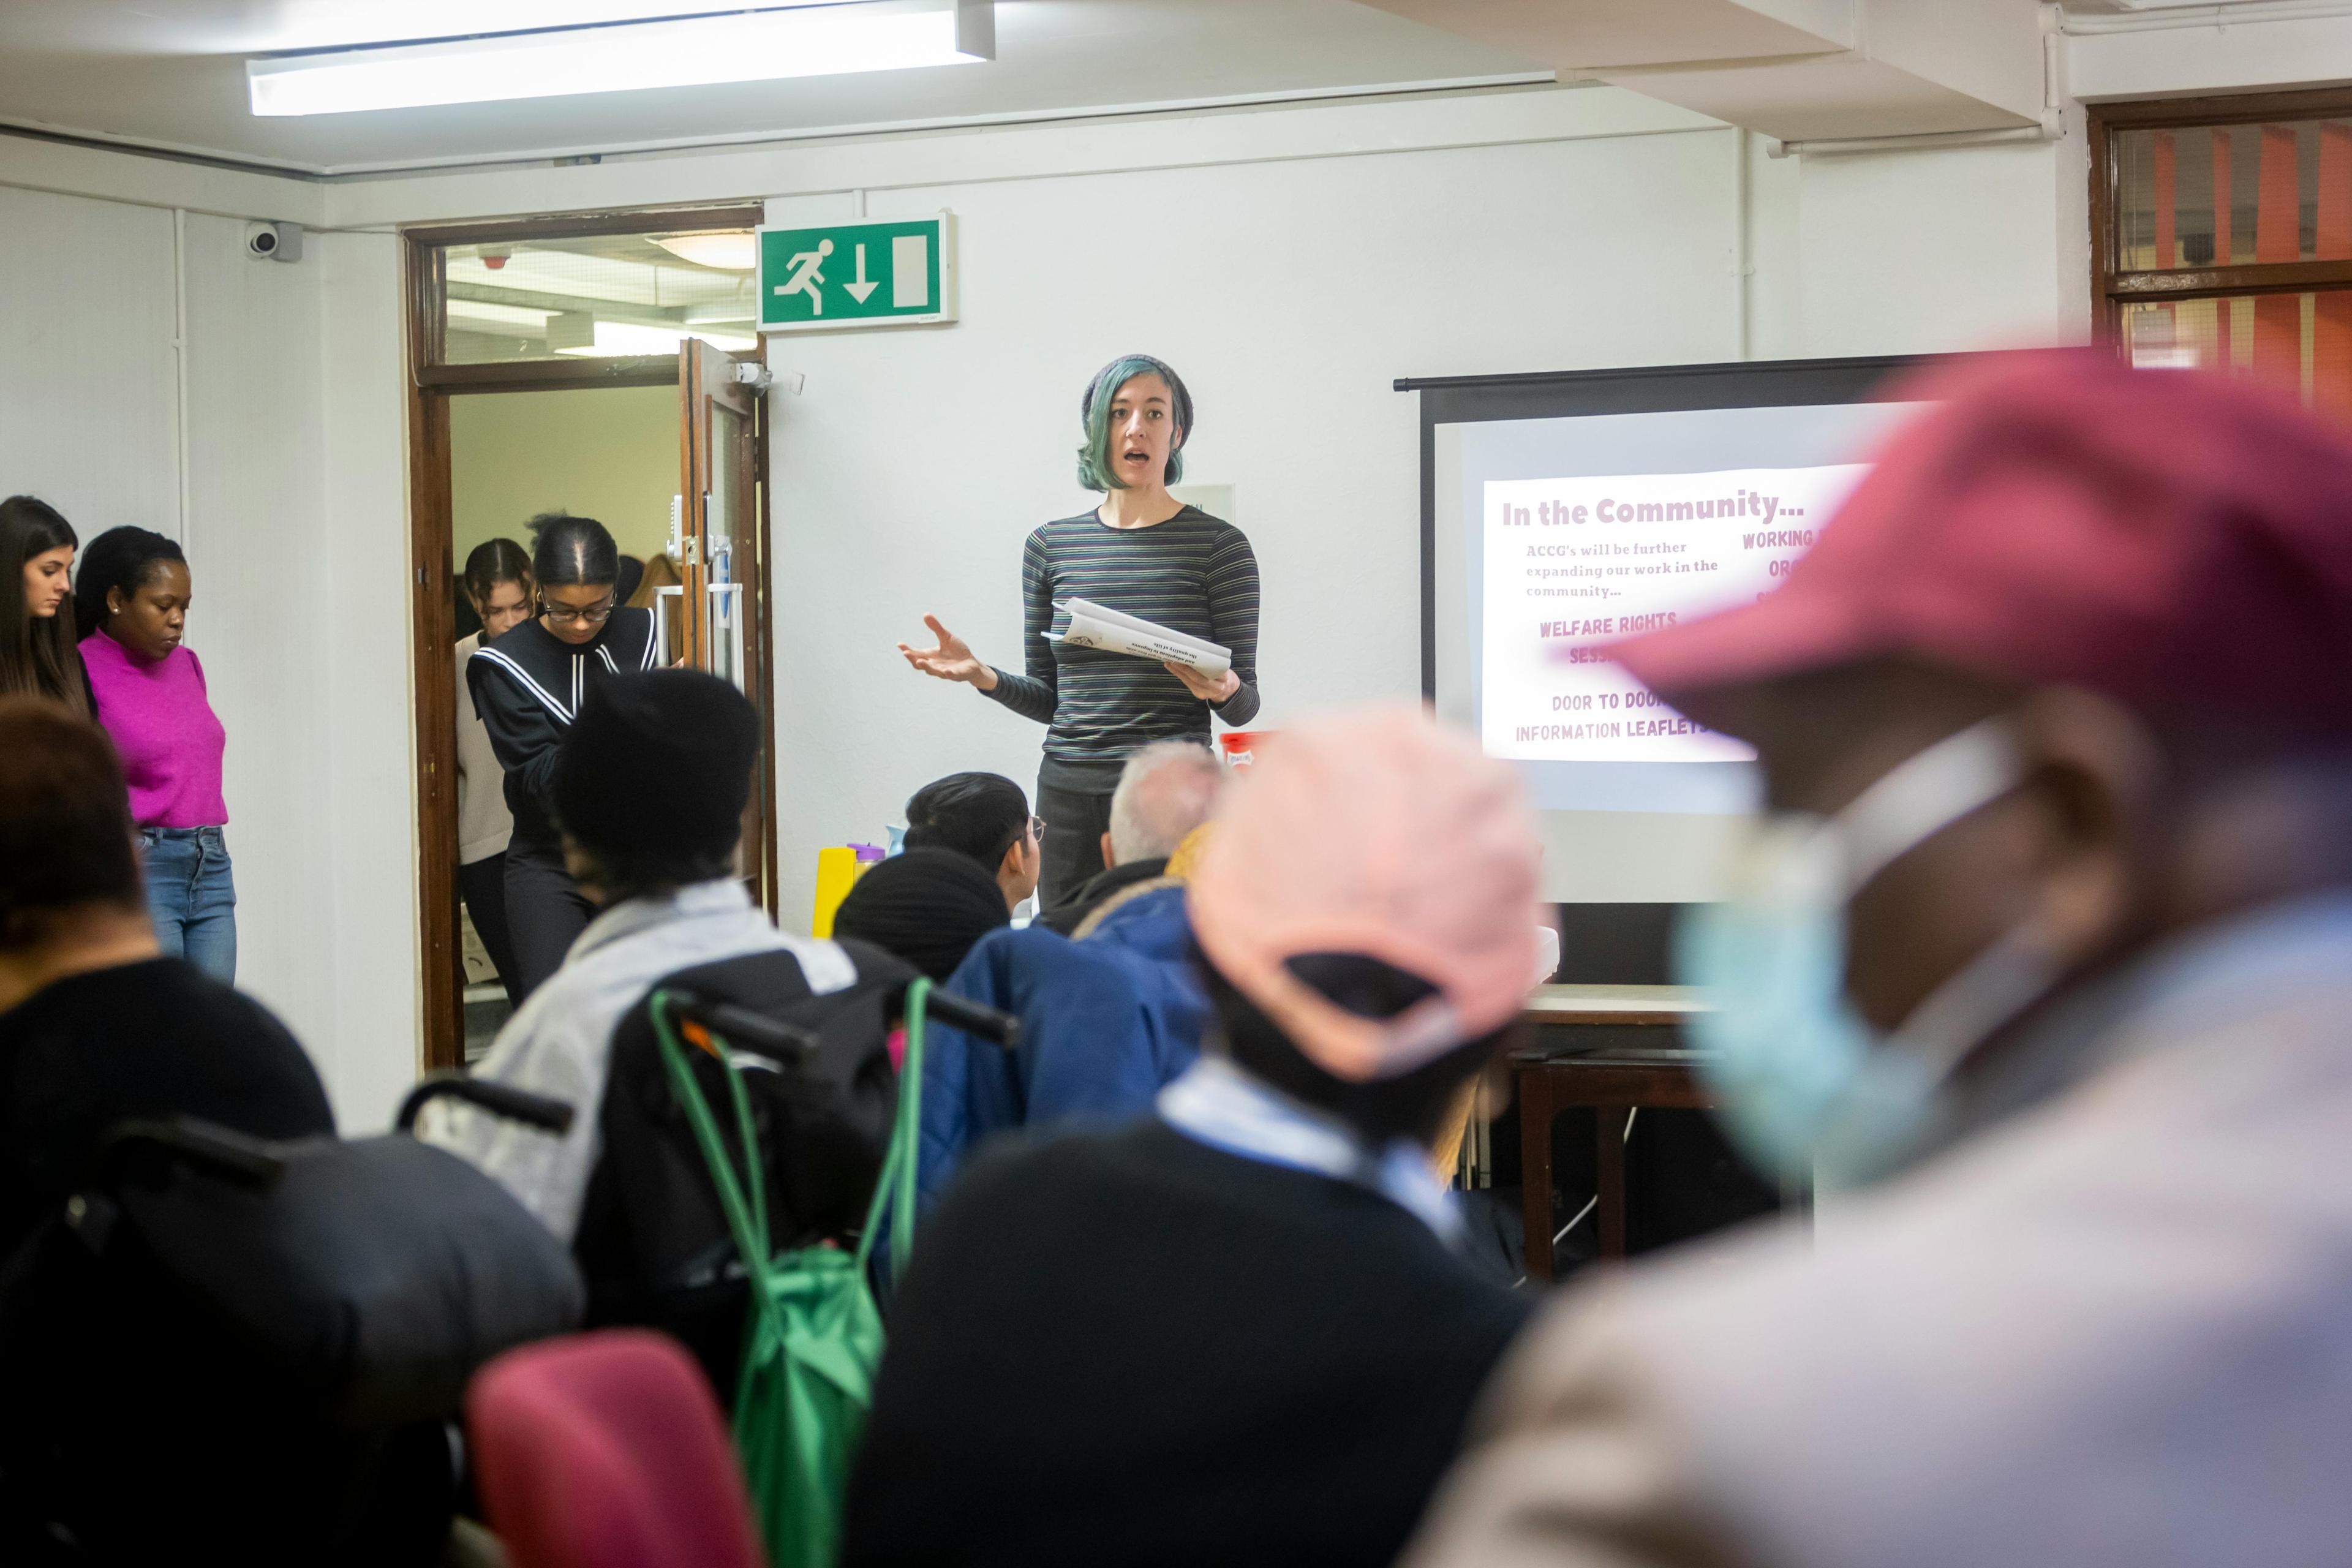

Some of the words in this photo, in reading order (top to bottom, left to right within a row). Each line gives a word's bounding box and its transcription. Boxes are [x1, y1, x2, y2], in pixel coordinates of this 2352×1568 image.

[1503, 502, 1530, 526] In
[1538, 500, 1588, 526] the
[1596, 489, 1804, 524] Community...
[1526, 545, 1577, 556] ACCG's
[1580, 544, 1610, 556] will
[1613, 543, 1630, 555] be
[1634, 542, 1686, 554] further
[1743, 530, 1813, 549] WORKING
[1526, 565, 1602, 579] expanding
[1634, 563, 1672, 575] work
[1675, 562, 1691, 573] in
[1694, 560, 1718, 571] the
[1526, 586, 1621, 599] community...
[1540, 617, 1613, 638] WELFARE
[1619, 612, 1677, 633] RIGHTS
[1553, 695, 1592, 711] DOOR
[1599, 693, 1619, 709] TO
[1516, 722, 1620, 742] INFORMATION
